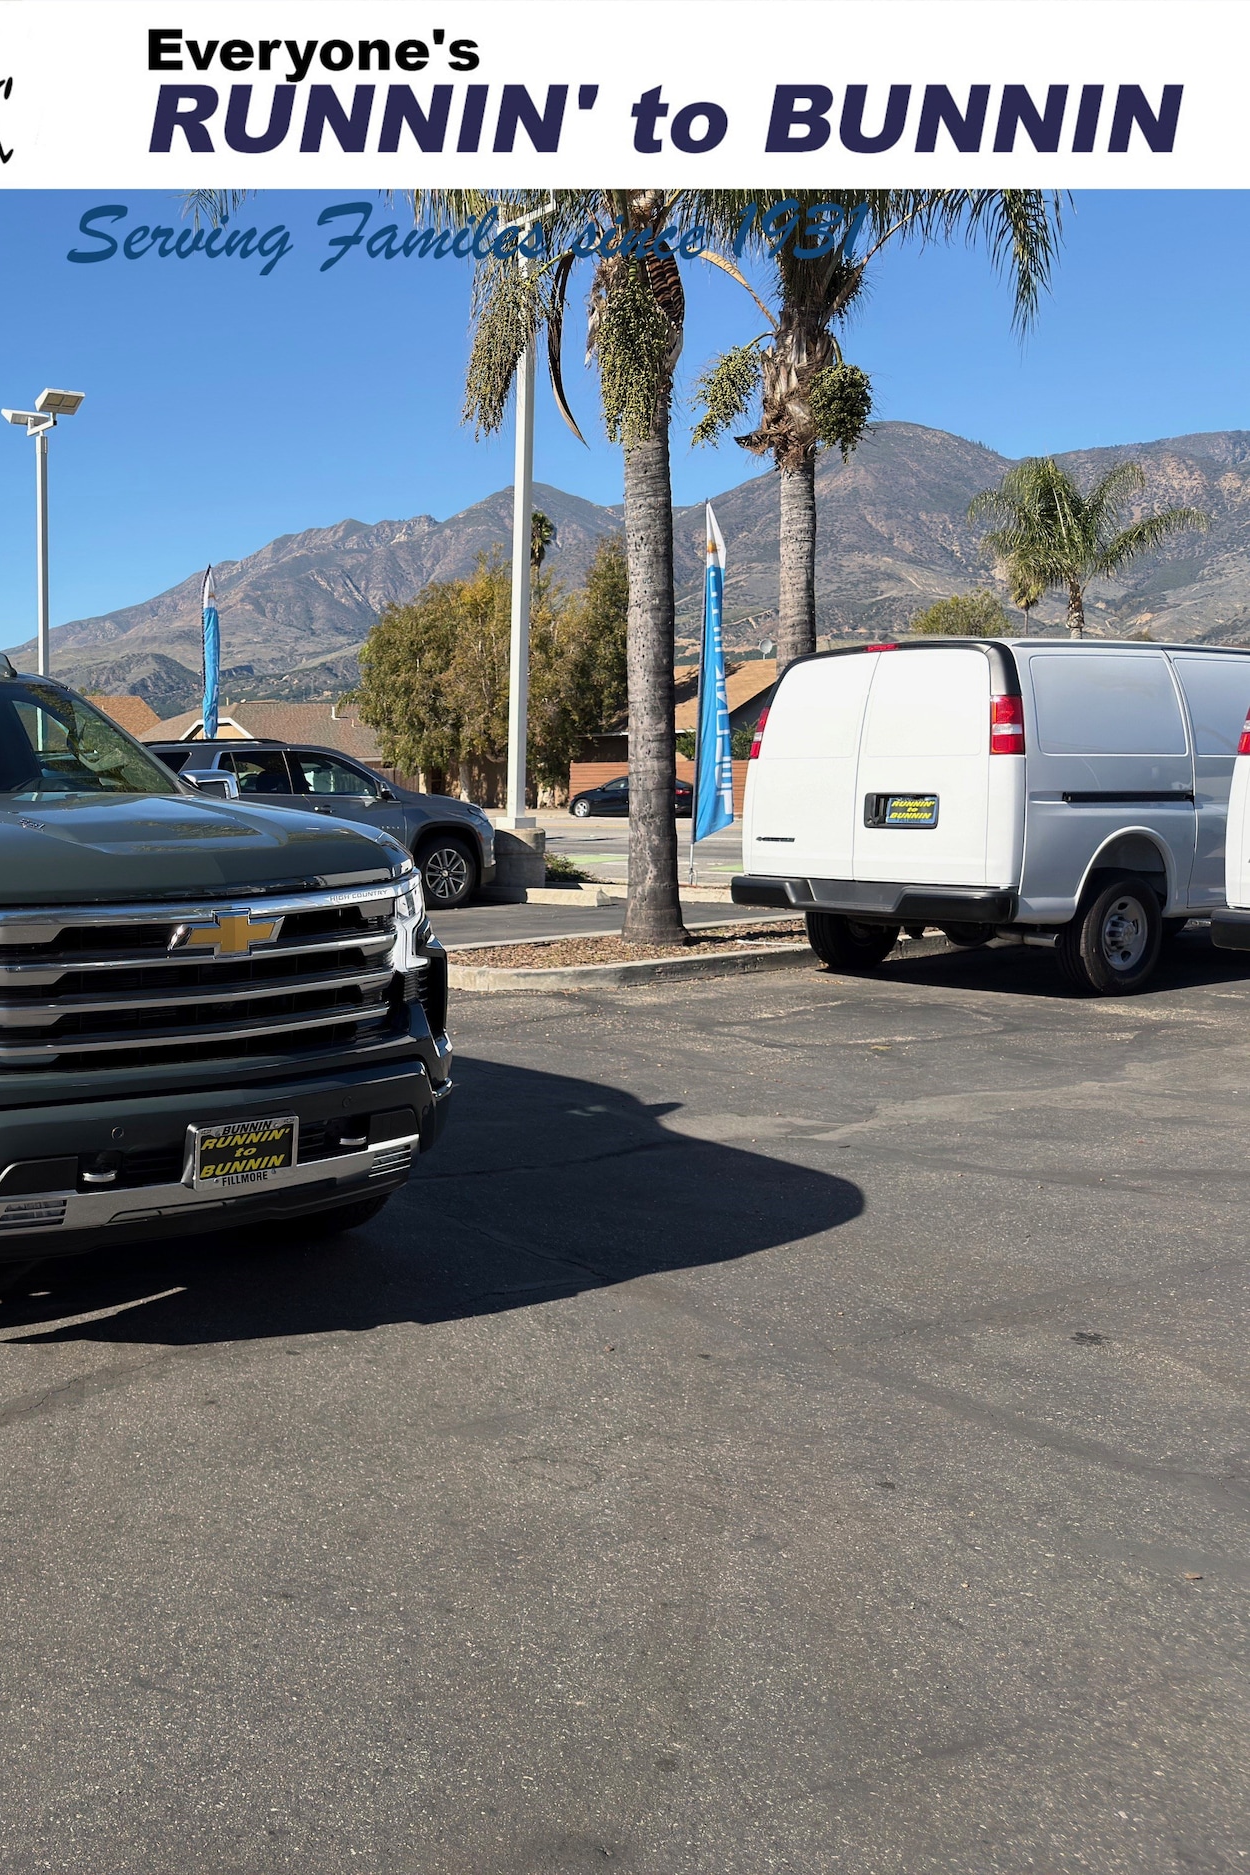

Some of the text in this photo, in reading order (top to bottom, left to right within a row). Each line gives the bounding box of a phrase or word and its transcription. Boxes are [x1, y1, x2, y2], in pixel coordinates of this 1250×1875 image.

[352, 889, 388, 899] COUNTRY
[222, 1120, 272, 1135] BUNNIN
[201, 1128, 290, 1150] RUNNIN'
[234, 1147, 257, 1157] to
[200, 1154, 285, 1178] BUNNIN
[221, 1170, 268, 1187] FILLMORE
